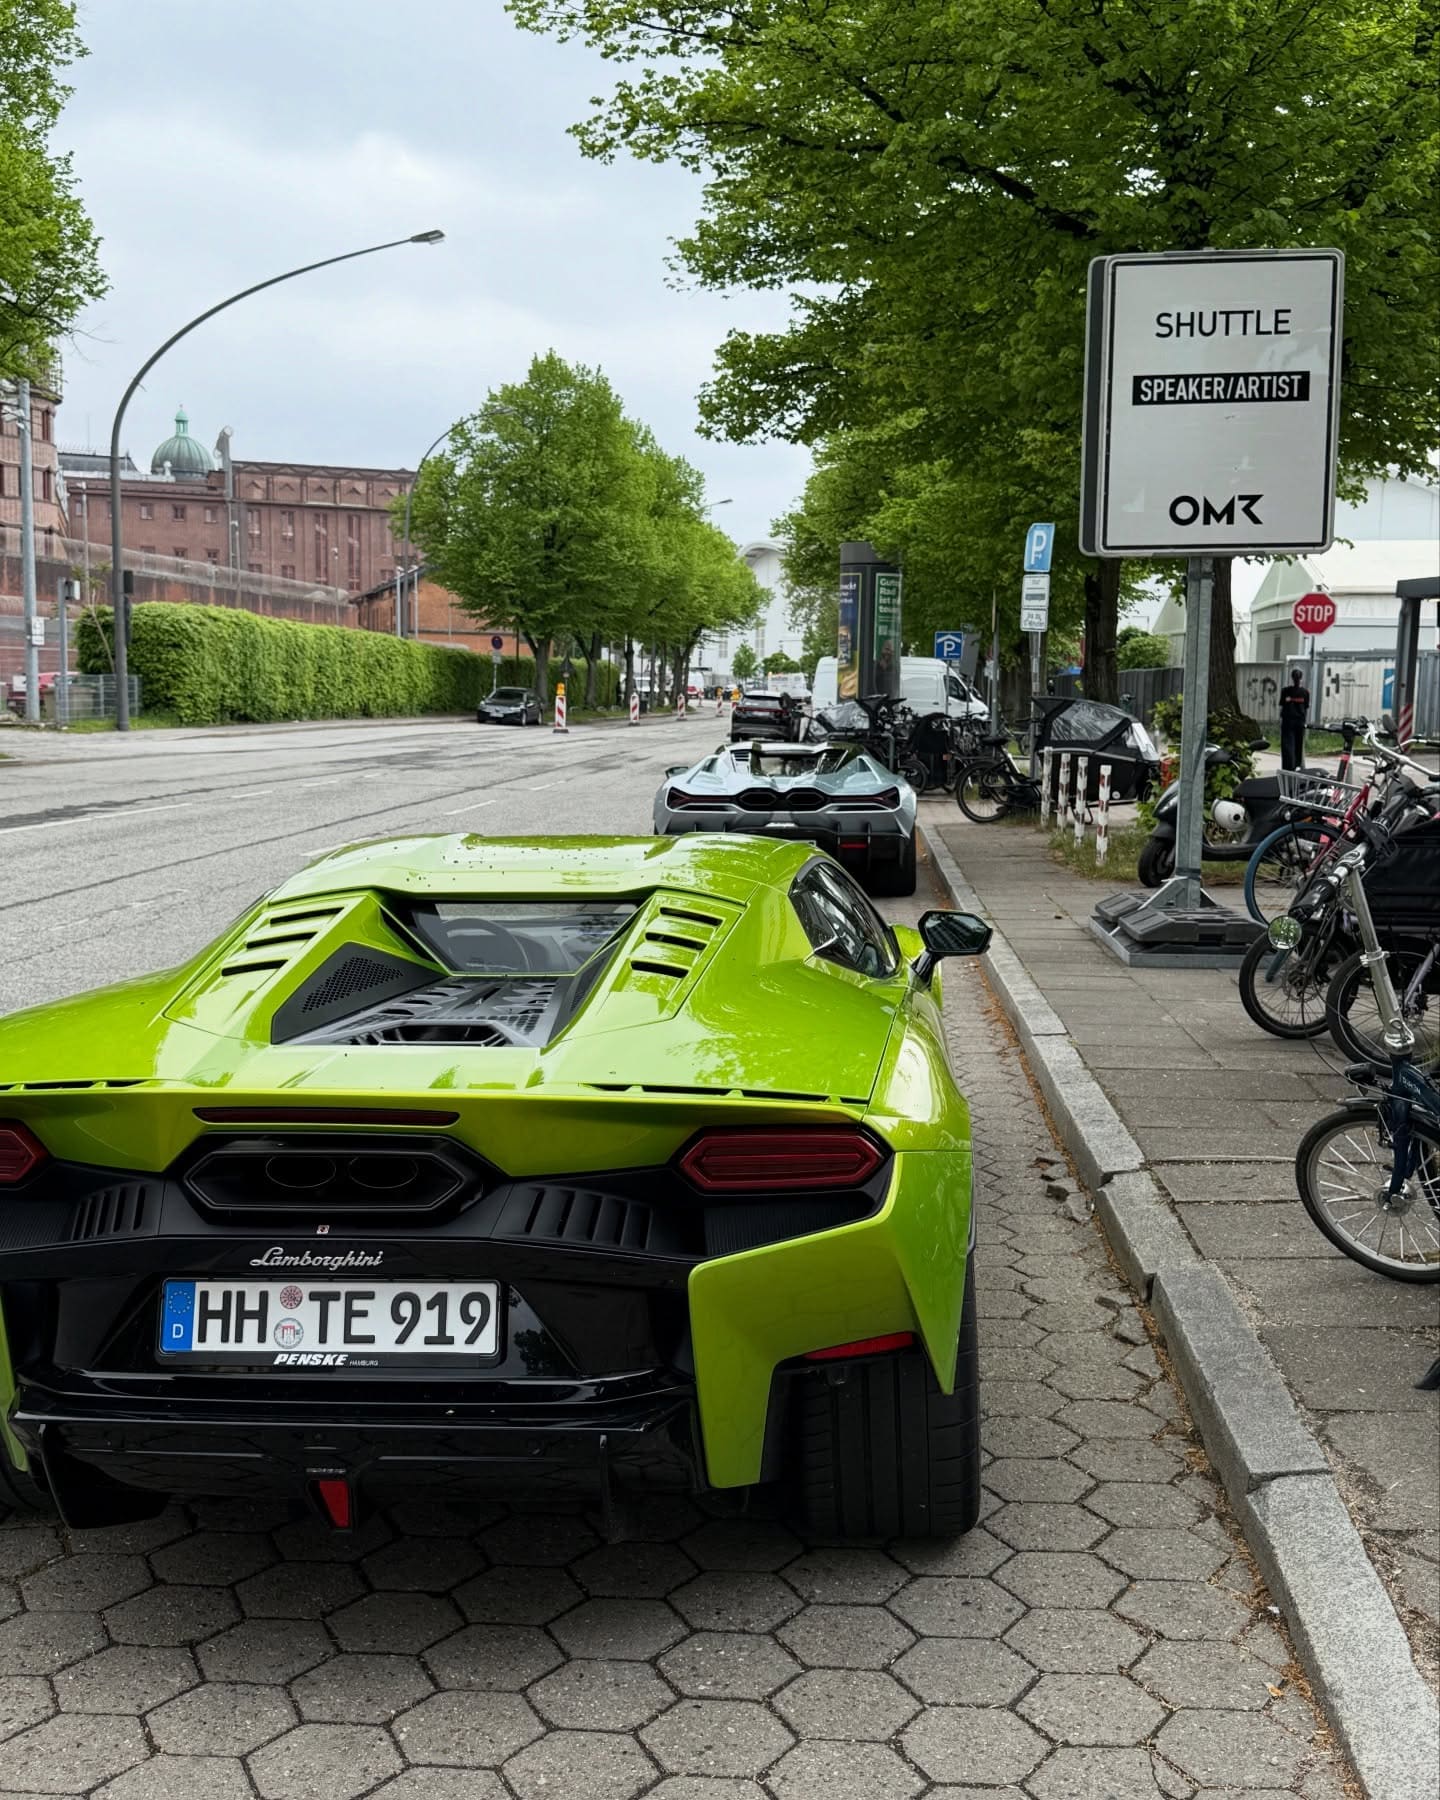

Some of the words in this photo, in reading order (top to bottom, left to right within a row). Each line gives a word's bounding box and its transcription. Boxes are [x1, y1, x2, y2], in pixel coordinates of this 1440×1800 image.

[1155, 309, 1292, 338] SHUTTLE
[1140, 375, 1302, 402] SPEAKER/ARTIST
[1169, 494, 1264, 526] OMR
[1296, 605, 1334, 622] STOP
[943, 640, 956, 657] P
[250, 1247, 383, 1270] Lamborghini
[198, 1290, 269, 1344] HH
[309, 1290, 376, 1345] TE
[390, 1291, 491, 1345] 919
[172, 1323, 184, 1339] D
[273, 1353, 349, 1366] PENSKE
